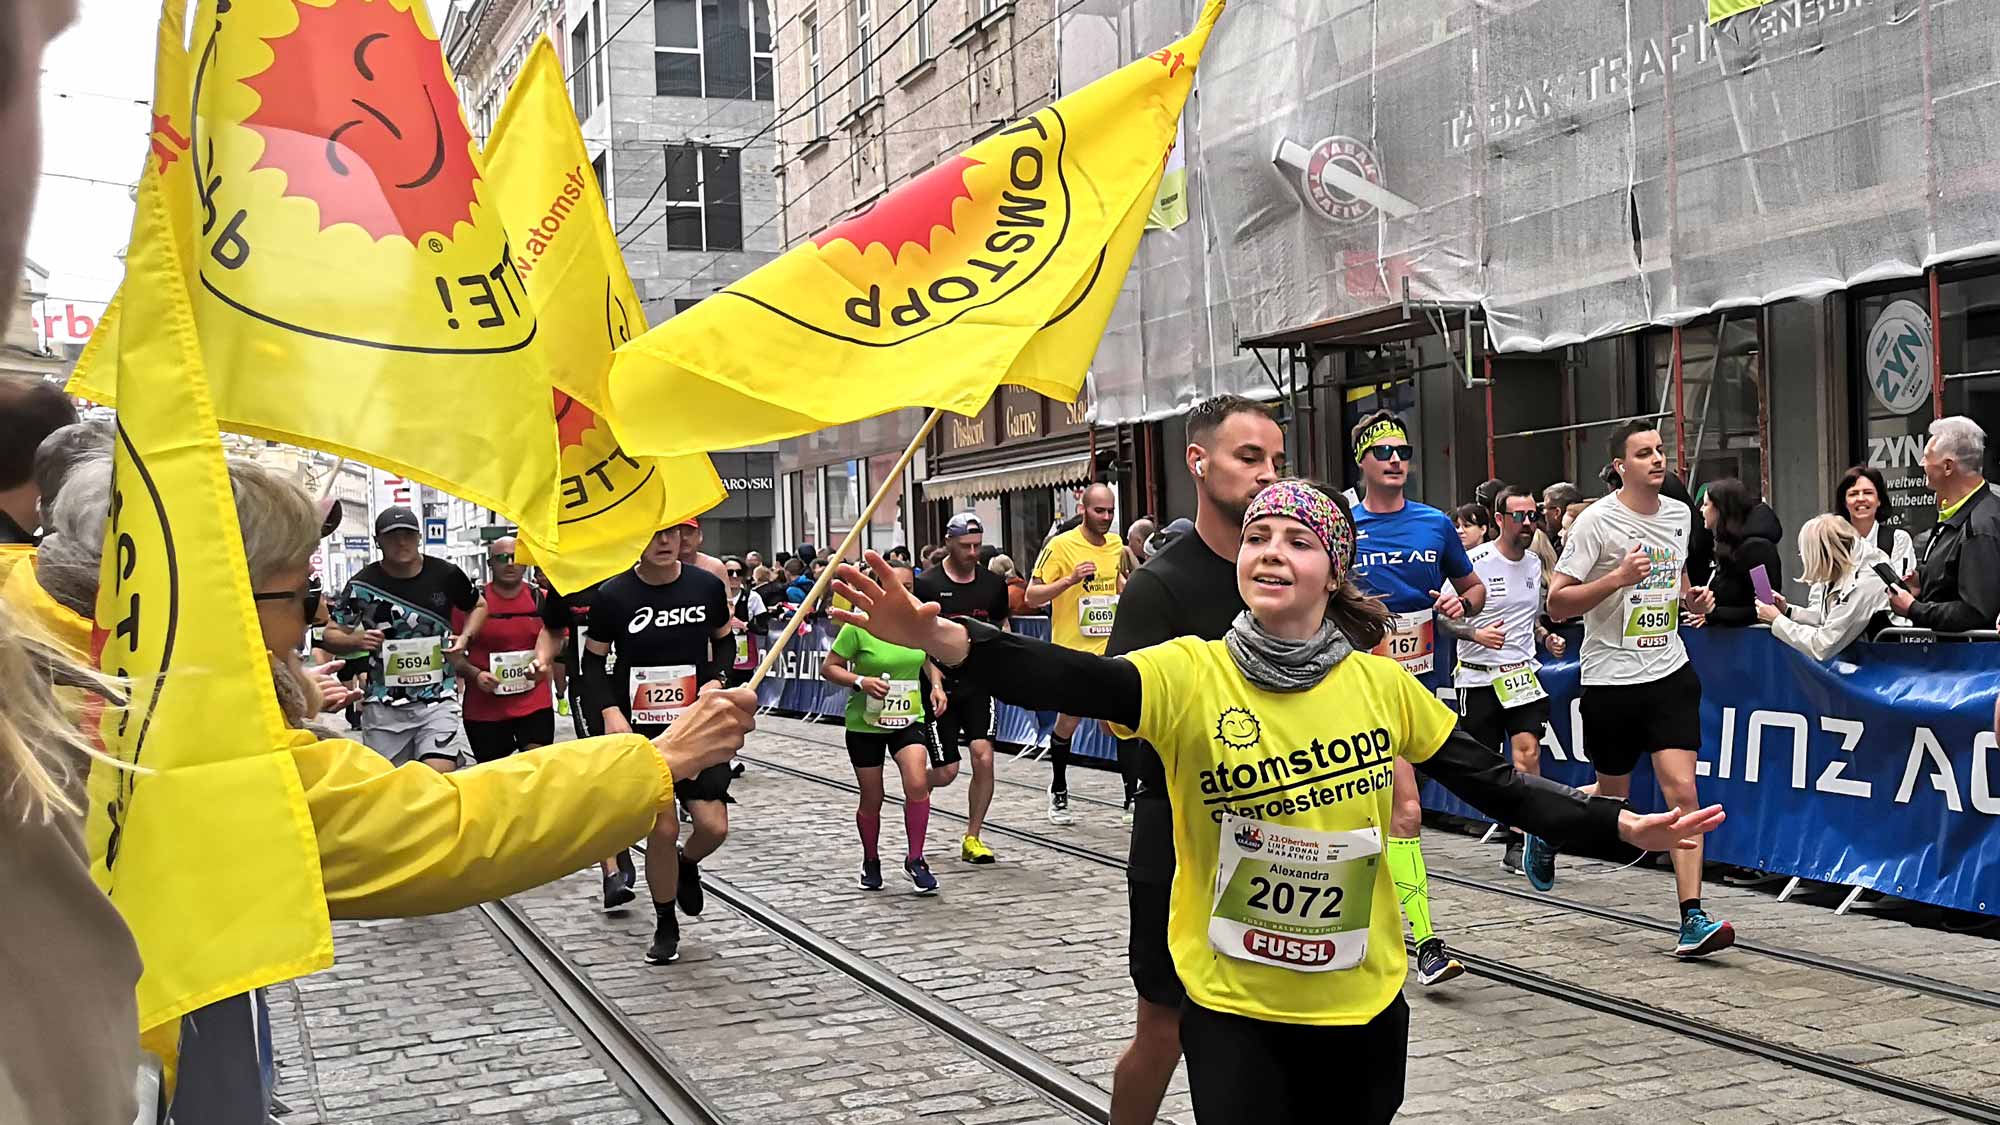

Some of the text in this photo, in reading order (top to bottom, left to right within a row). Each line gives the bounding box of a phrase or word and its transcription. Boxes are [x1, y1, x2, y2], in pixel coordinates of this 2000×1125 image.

[1875, 323, 1923, 403] ZYN
[1868, 434, 1925, 469] ZYN
[1407, 550, 1437, 563] AG
[1088, 610, 1113, 621] 6669
[1637, 612, 1670, 628] 4950
[1389, 637, 1418, 654] 167
[397, 656, 431, 670] 5694
[1505, 673, 1533, 691] 2715
[645, 688, 684, 703] 1226
[1200, 728, 1391, 795] atomstopp
[1267, 848, 1318, 862] MARATHON
[1289, 845, 1319, 855] DONAU
[1269, 863, 1329, 881] Alexandra
[1247, 876, 1344, 919] 2072
[1252, 932, 1329, 962] FUSSL
